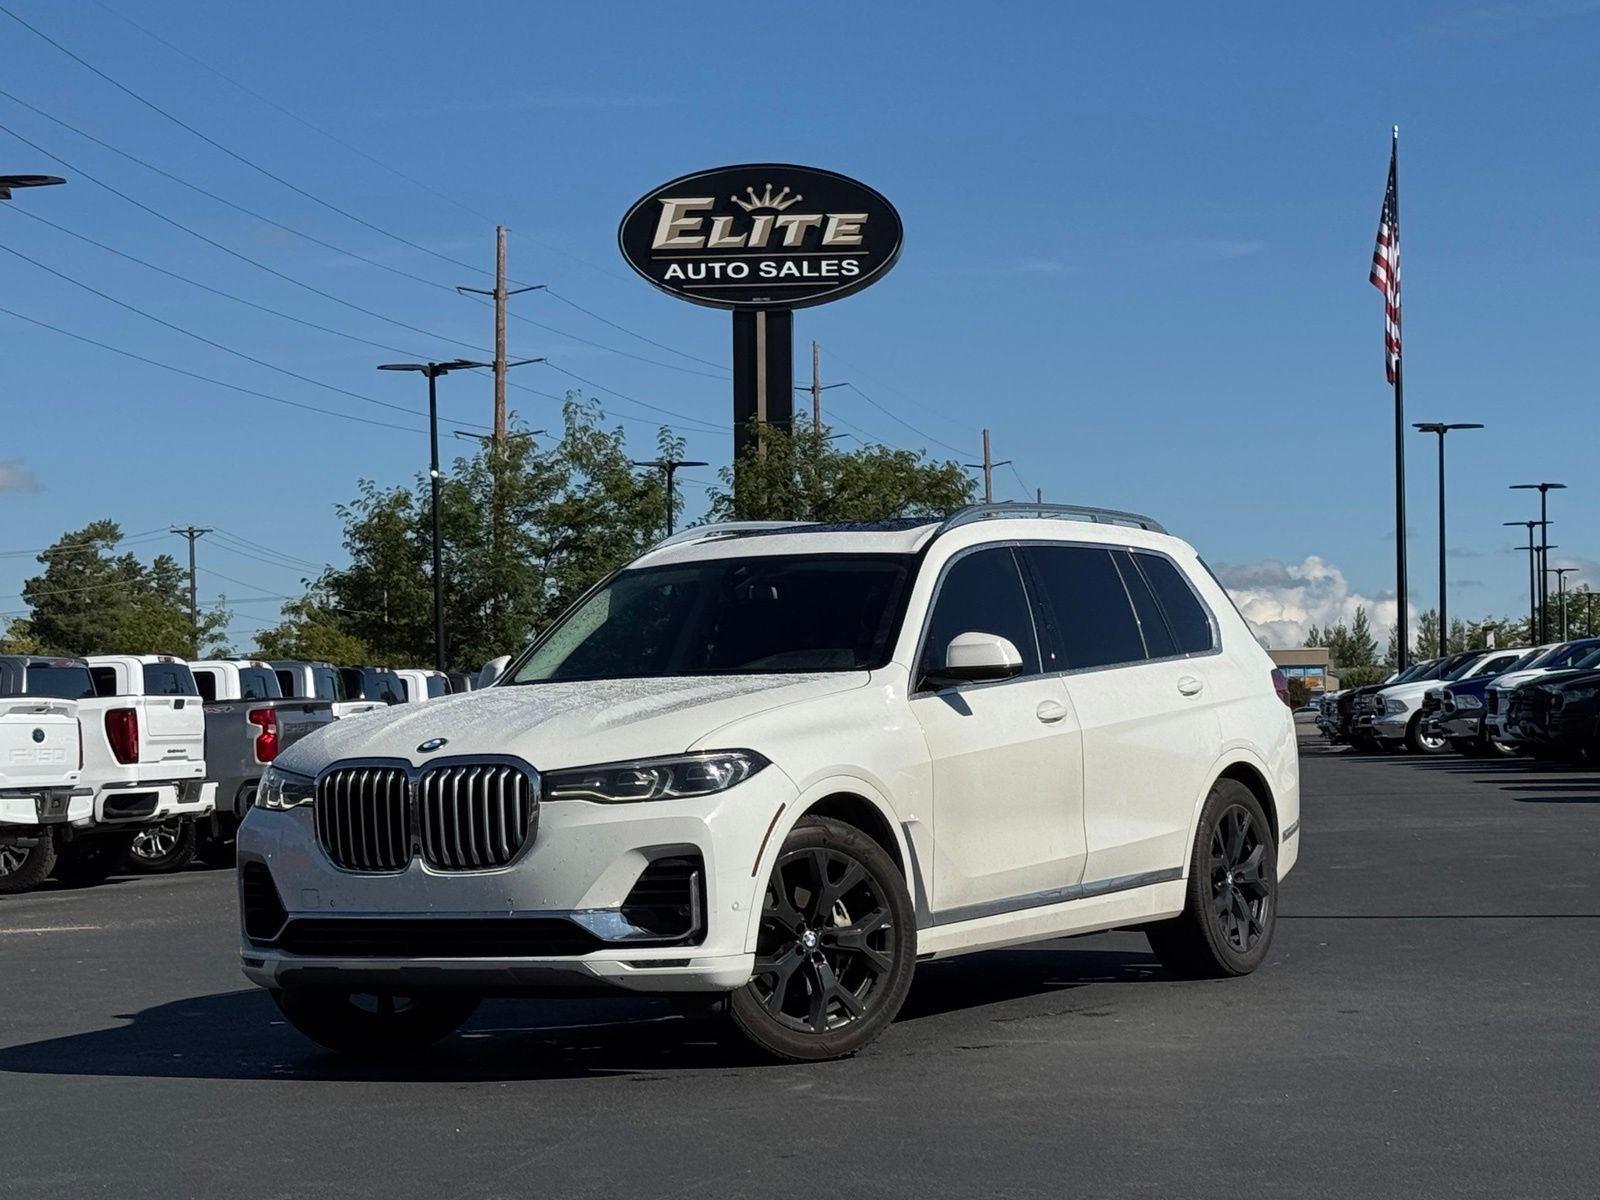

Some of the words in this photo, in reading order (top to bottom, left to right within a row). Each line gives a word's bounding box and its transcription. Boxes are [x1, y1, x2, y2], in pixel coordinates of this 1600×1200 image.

[651, 197, 869, 249] ELITE
[664, 262, 749, 280] AUTO
[759, 260, 860, 278] SALES
